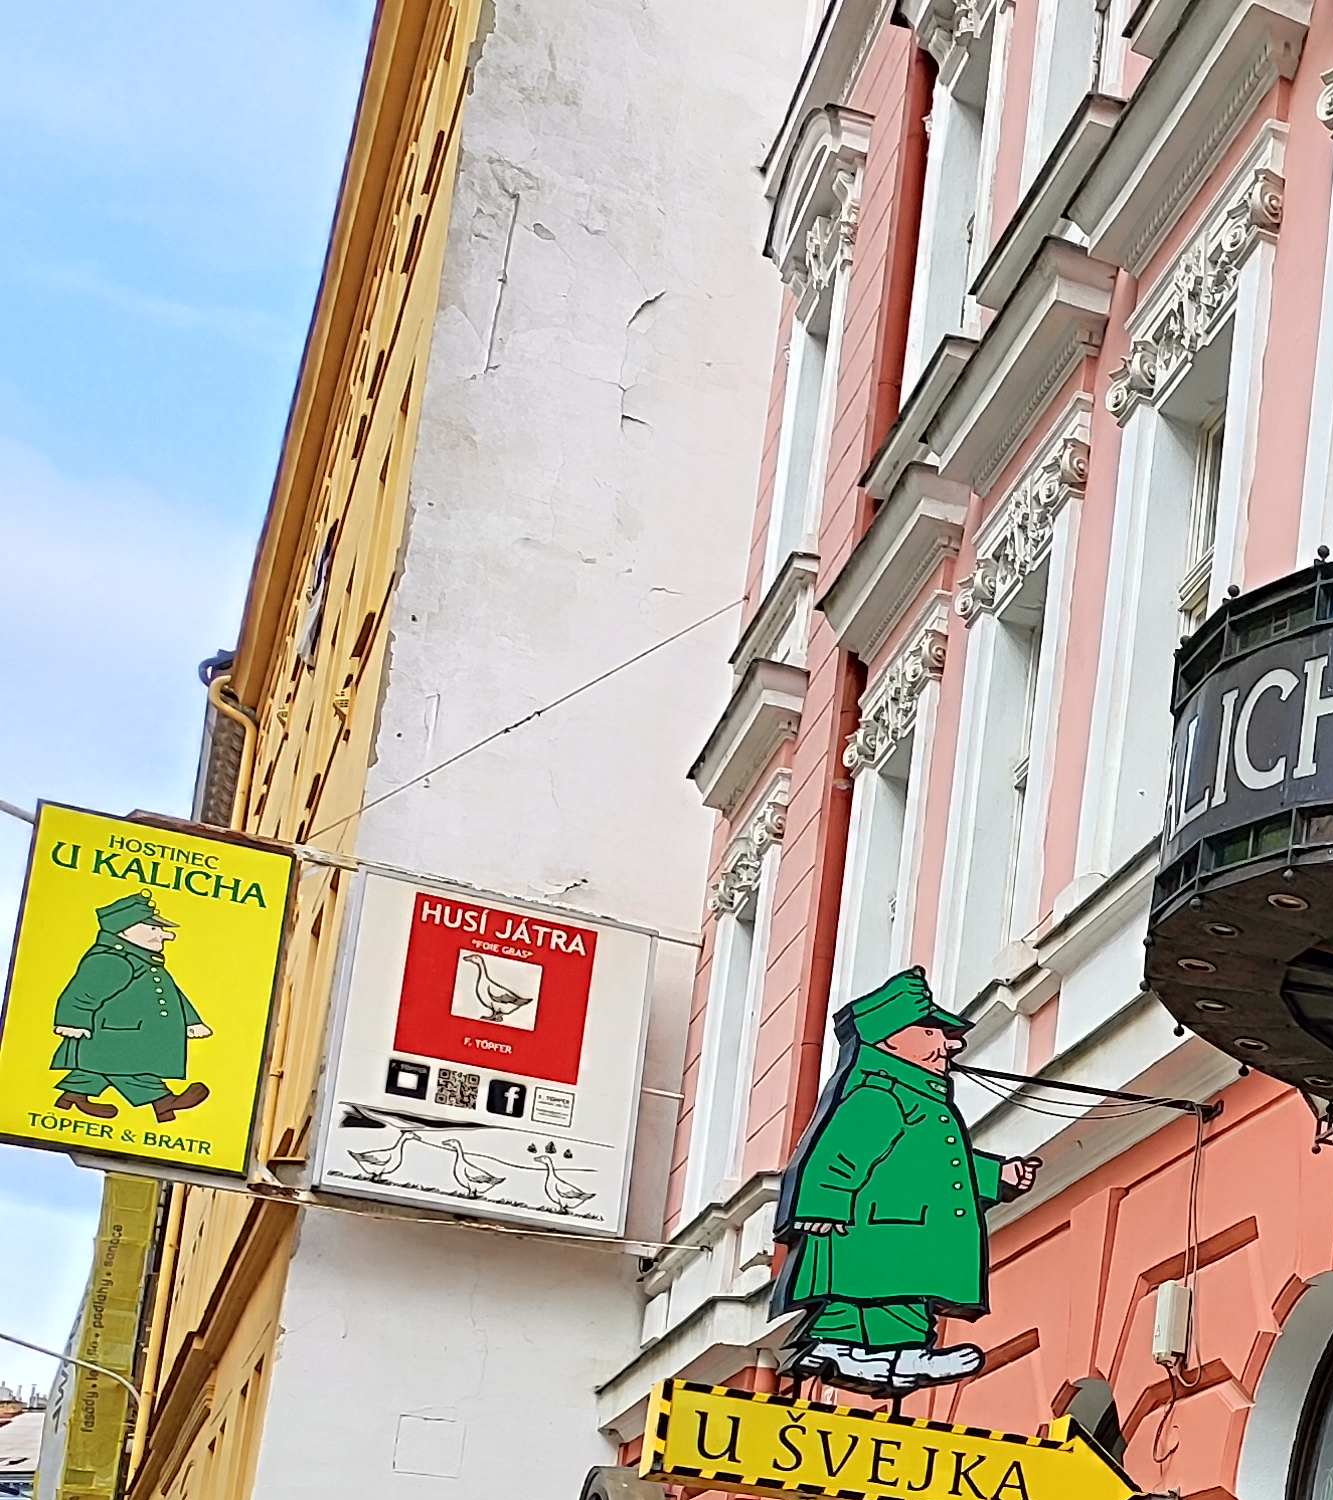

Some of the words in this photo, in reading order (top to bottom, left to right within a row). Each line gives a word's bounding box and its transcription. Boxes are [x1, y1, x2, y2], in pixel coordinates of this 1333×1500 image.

[51, 841, 80, 869] U
[92, 849, 267, 908] KALICHA
[108, 834, 219, 870] HOSTINEC
[421, 901, 490, 935] HUSÍ
[495, 918, 587, 957] JÁTRA
[27, 1112, 114, 1140] TÖPFER
[120, 1129, 137, 1143] &
[143, 1131, 212, 1156] BRATR
[695, 1409, 741, 1463] U
